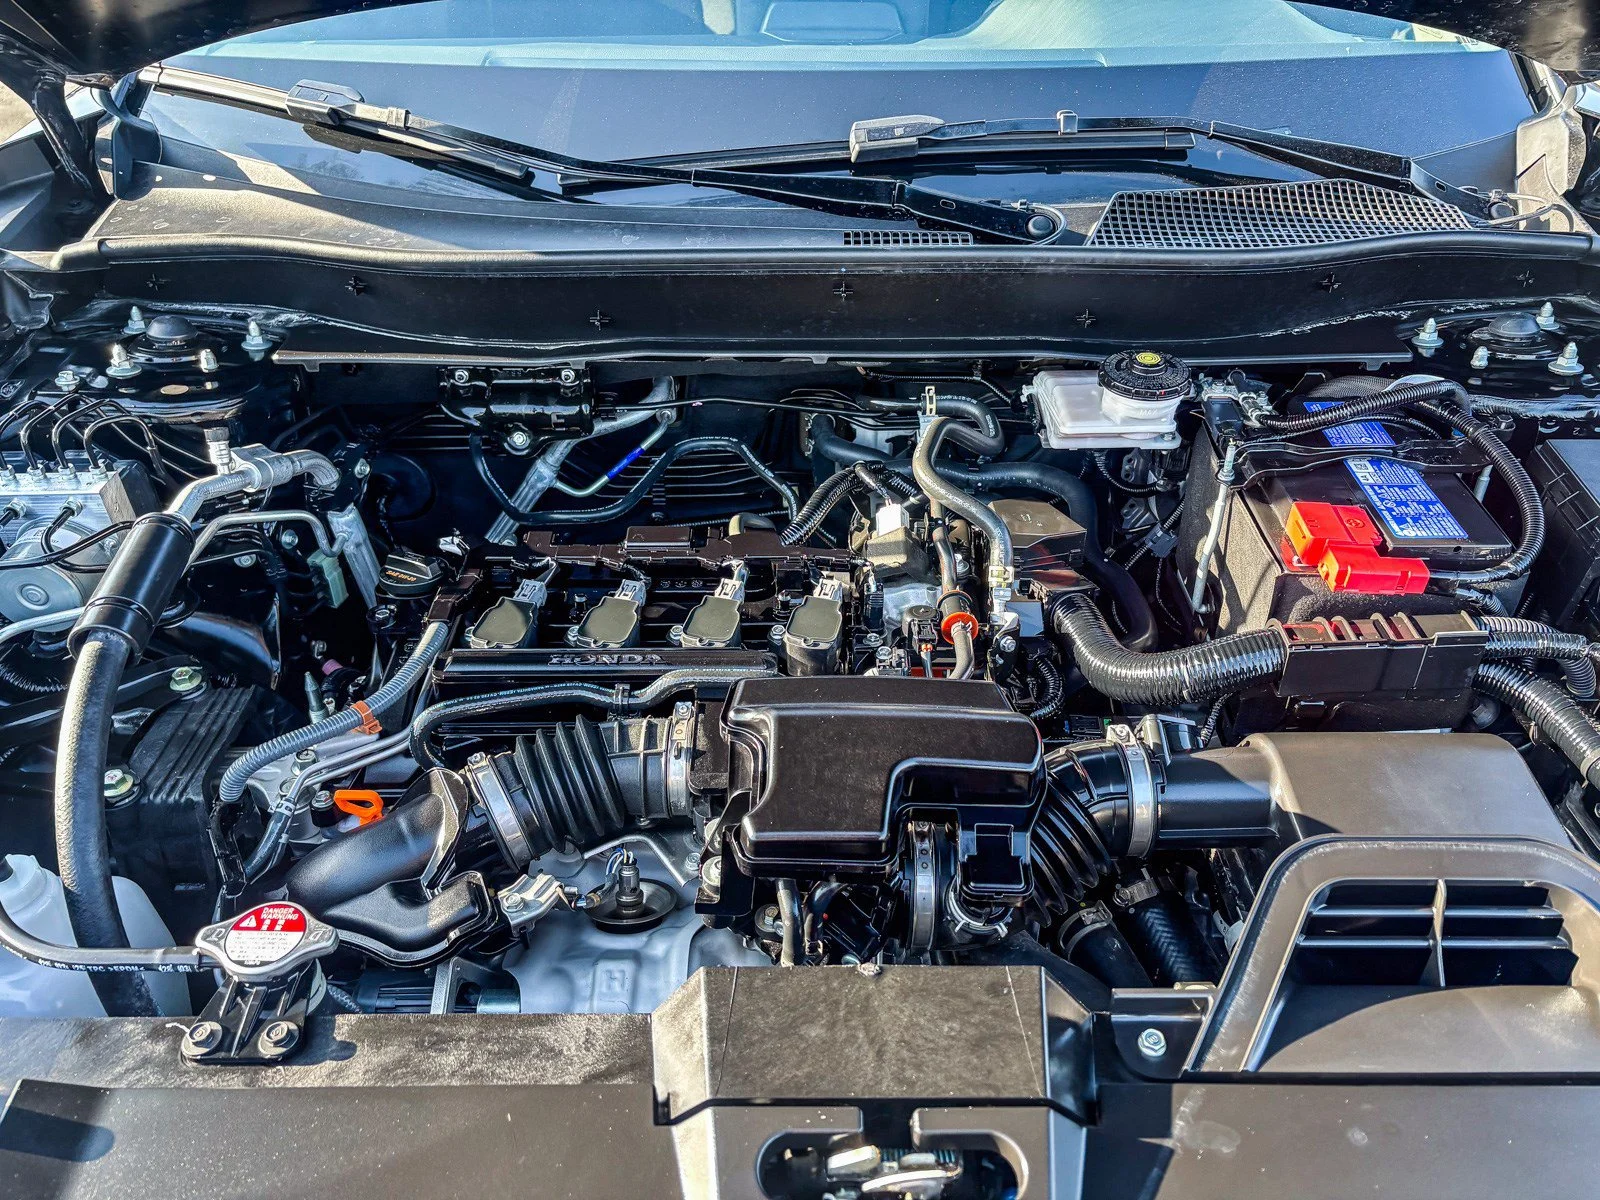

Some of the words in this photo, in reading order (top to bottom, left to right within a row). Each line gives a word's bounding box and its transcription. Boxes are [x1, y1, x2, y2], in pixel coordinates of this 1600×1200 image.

[547, 653, 668, 666] HONDA
[262, 906, 295, 915] DANGER
[260, 913, 299, 921] WARNUNG
